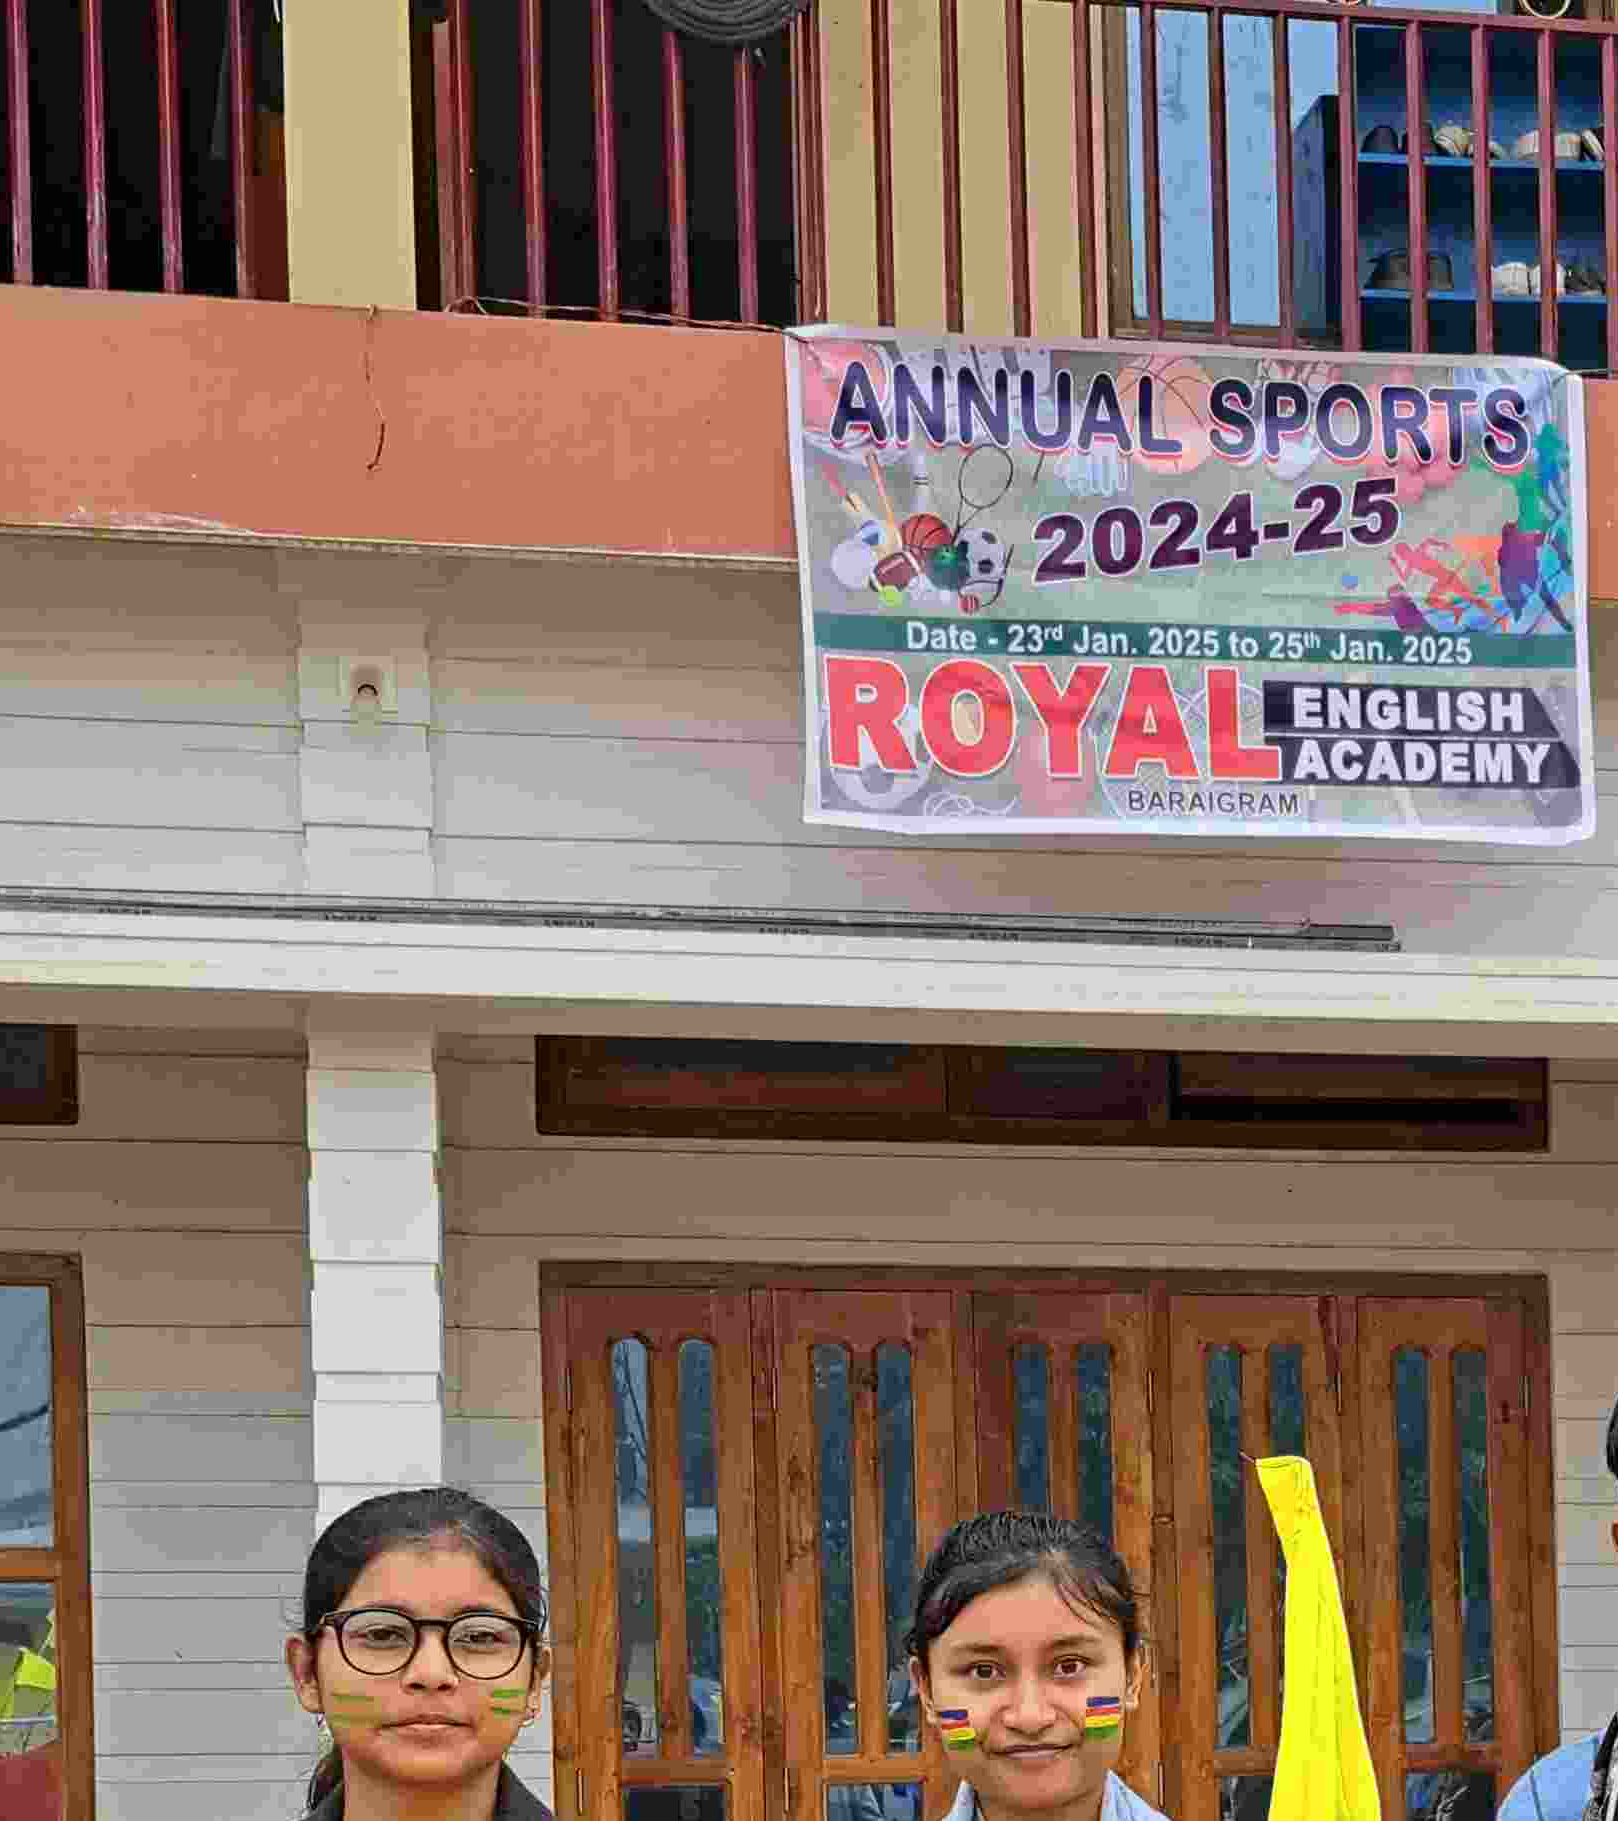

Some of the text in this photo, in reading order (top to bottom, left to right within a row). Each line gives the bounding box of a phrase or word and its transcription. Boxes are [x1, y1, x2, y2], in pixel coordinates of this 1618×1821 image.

[829, 360, 1533, 468] ANNUAL SPORTS
[1032, 477, 1401, 585] 2024-25
[906, 620, 979, 653] Date
[1007, 624, 1063, 656] 23rd
[1072, 625, 1137, 658] Jan.
[1148, 627, 1219, 658] 2025
[1230, 631, 1259, 658] to
[1268, 630, 1321, 661] 25th
[1331, 635, 1392, 664] Jan.
[1402, 635, 1472, 665] 2025
[821, 653, 1284, 783] ROYAL
[1293, 688, 1526, 732] ENGLISH
[1302, 740, 1551, 785] ACADEMY
[1128, 790, 1300, 816] BARAIGRAM
